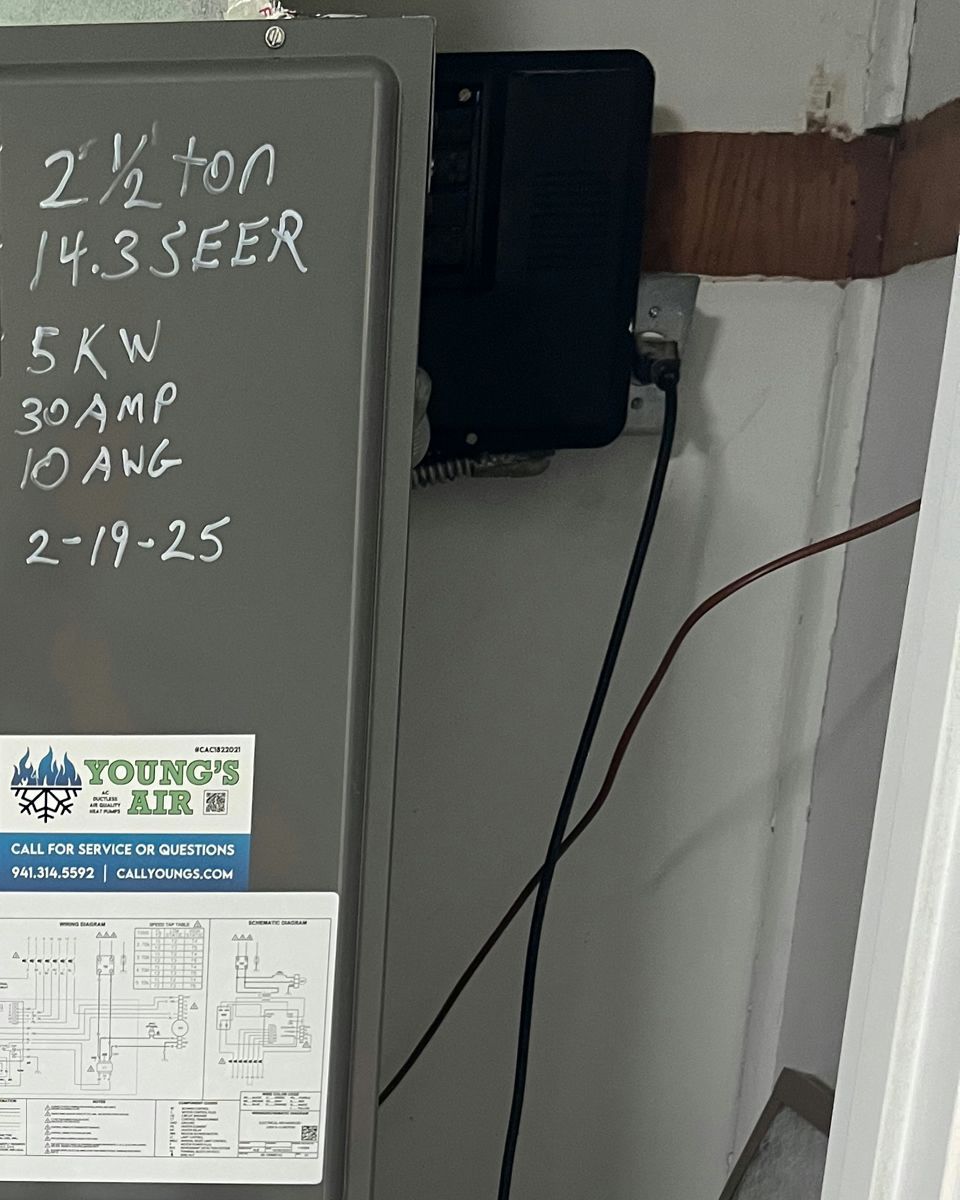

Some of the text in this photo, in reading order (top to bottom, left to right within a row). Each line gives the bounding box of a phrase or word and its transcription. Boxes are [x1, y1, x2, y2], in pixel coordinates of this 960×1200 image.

[39, 149, 89, 210] 2
[29, 209, 309, 291] 14.3 SEER
[25, 325, 61, 375] 5
[14, 380, 178, 436] 30 AMP
[19, 446, 70, 491] 10
[25, 515, 231, 569] 2-19-25
[84, 759, 239, 785] YOUNG'S
[127, 789, 193, 815] AIR
[10, 843, 235, 857] CALL FOR SERVICE OR QUESTIONS
[12, 866, 233, 880] 941.314.5592 CALLYOUNGS.COM
